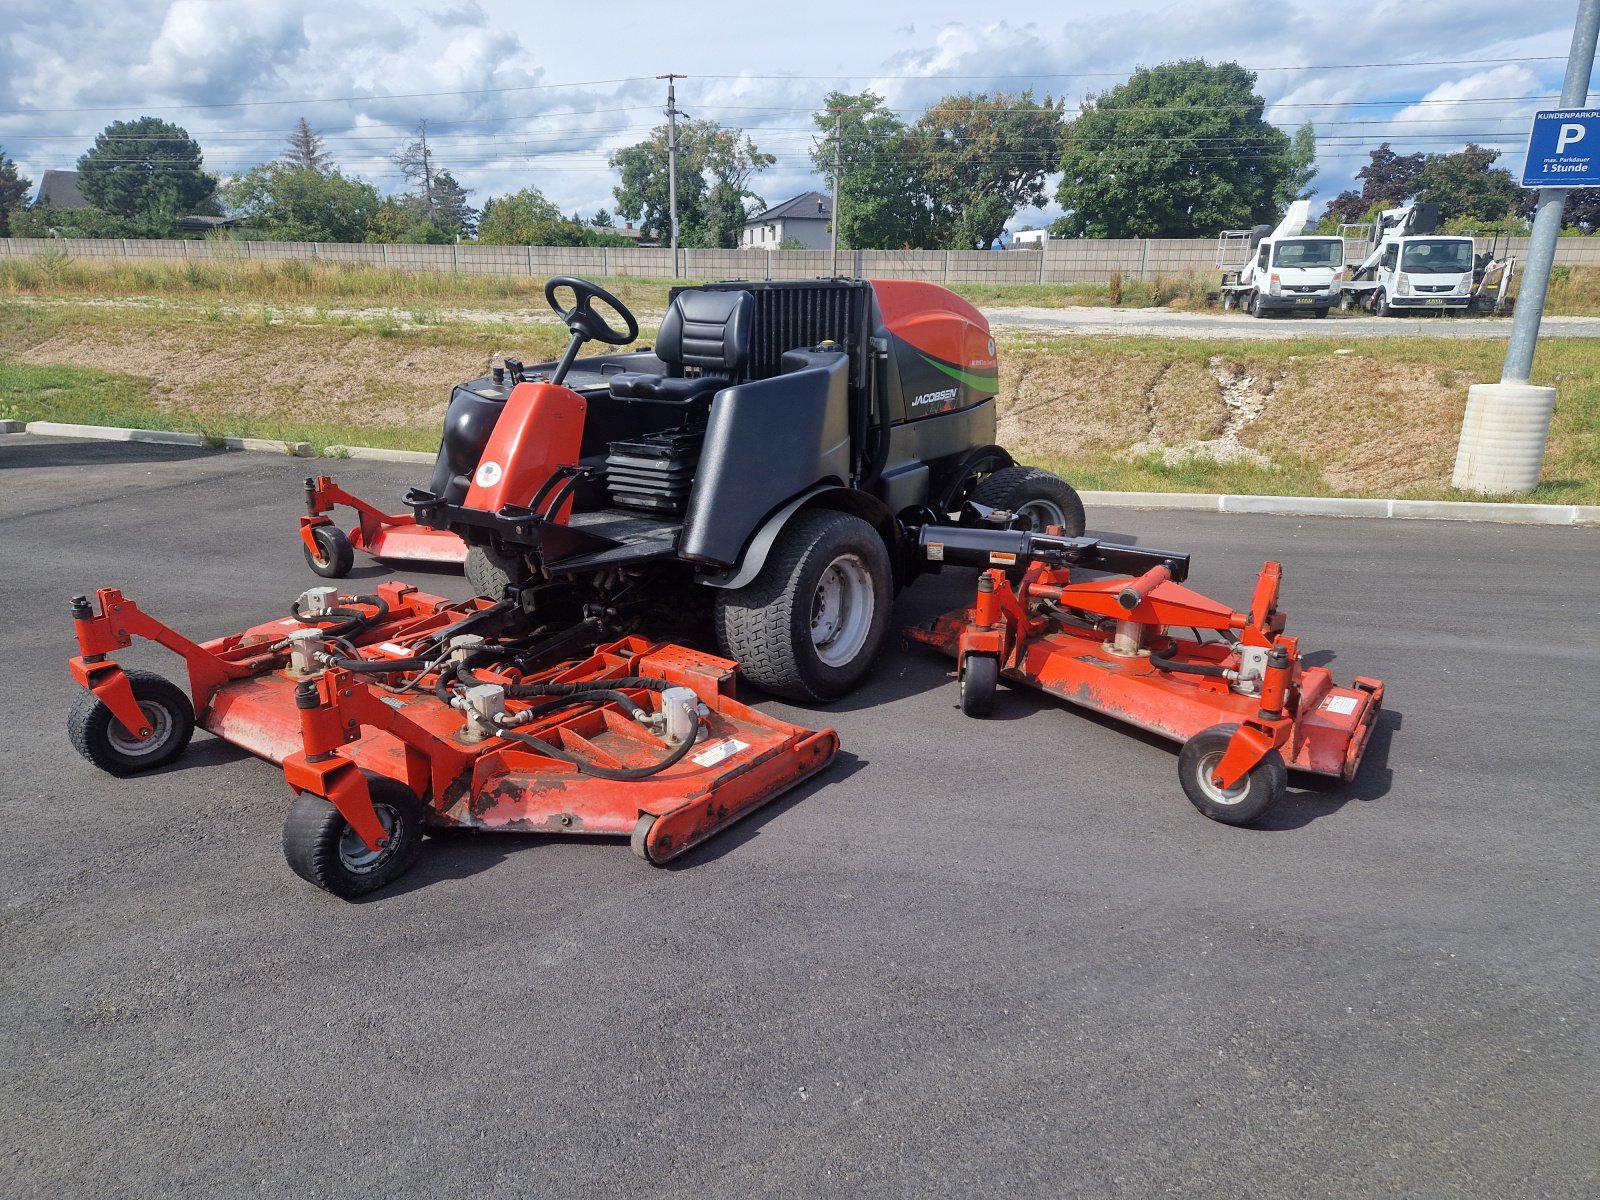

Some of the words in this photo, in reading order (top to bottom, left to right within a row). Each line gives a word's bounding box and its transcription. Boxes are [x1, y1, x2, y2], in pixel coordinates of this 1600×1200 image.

[1555, 123, 1586, 154] P
[1542, 164, 1549, 173] 1
[1551, 163, 1588, 173] Stunde
[911, 388, 958, 407] JACOBSEN
